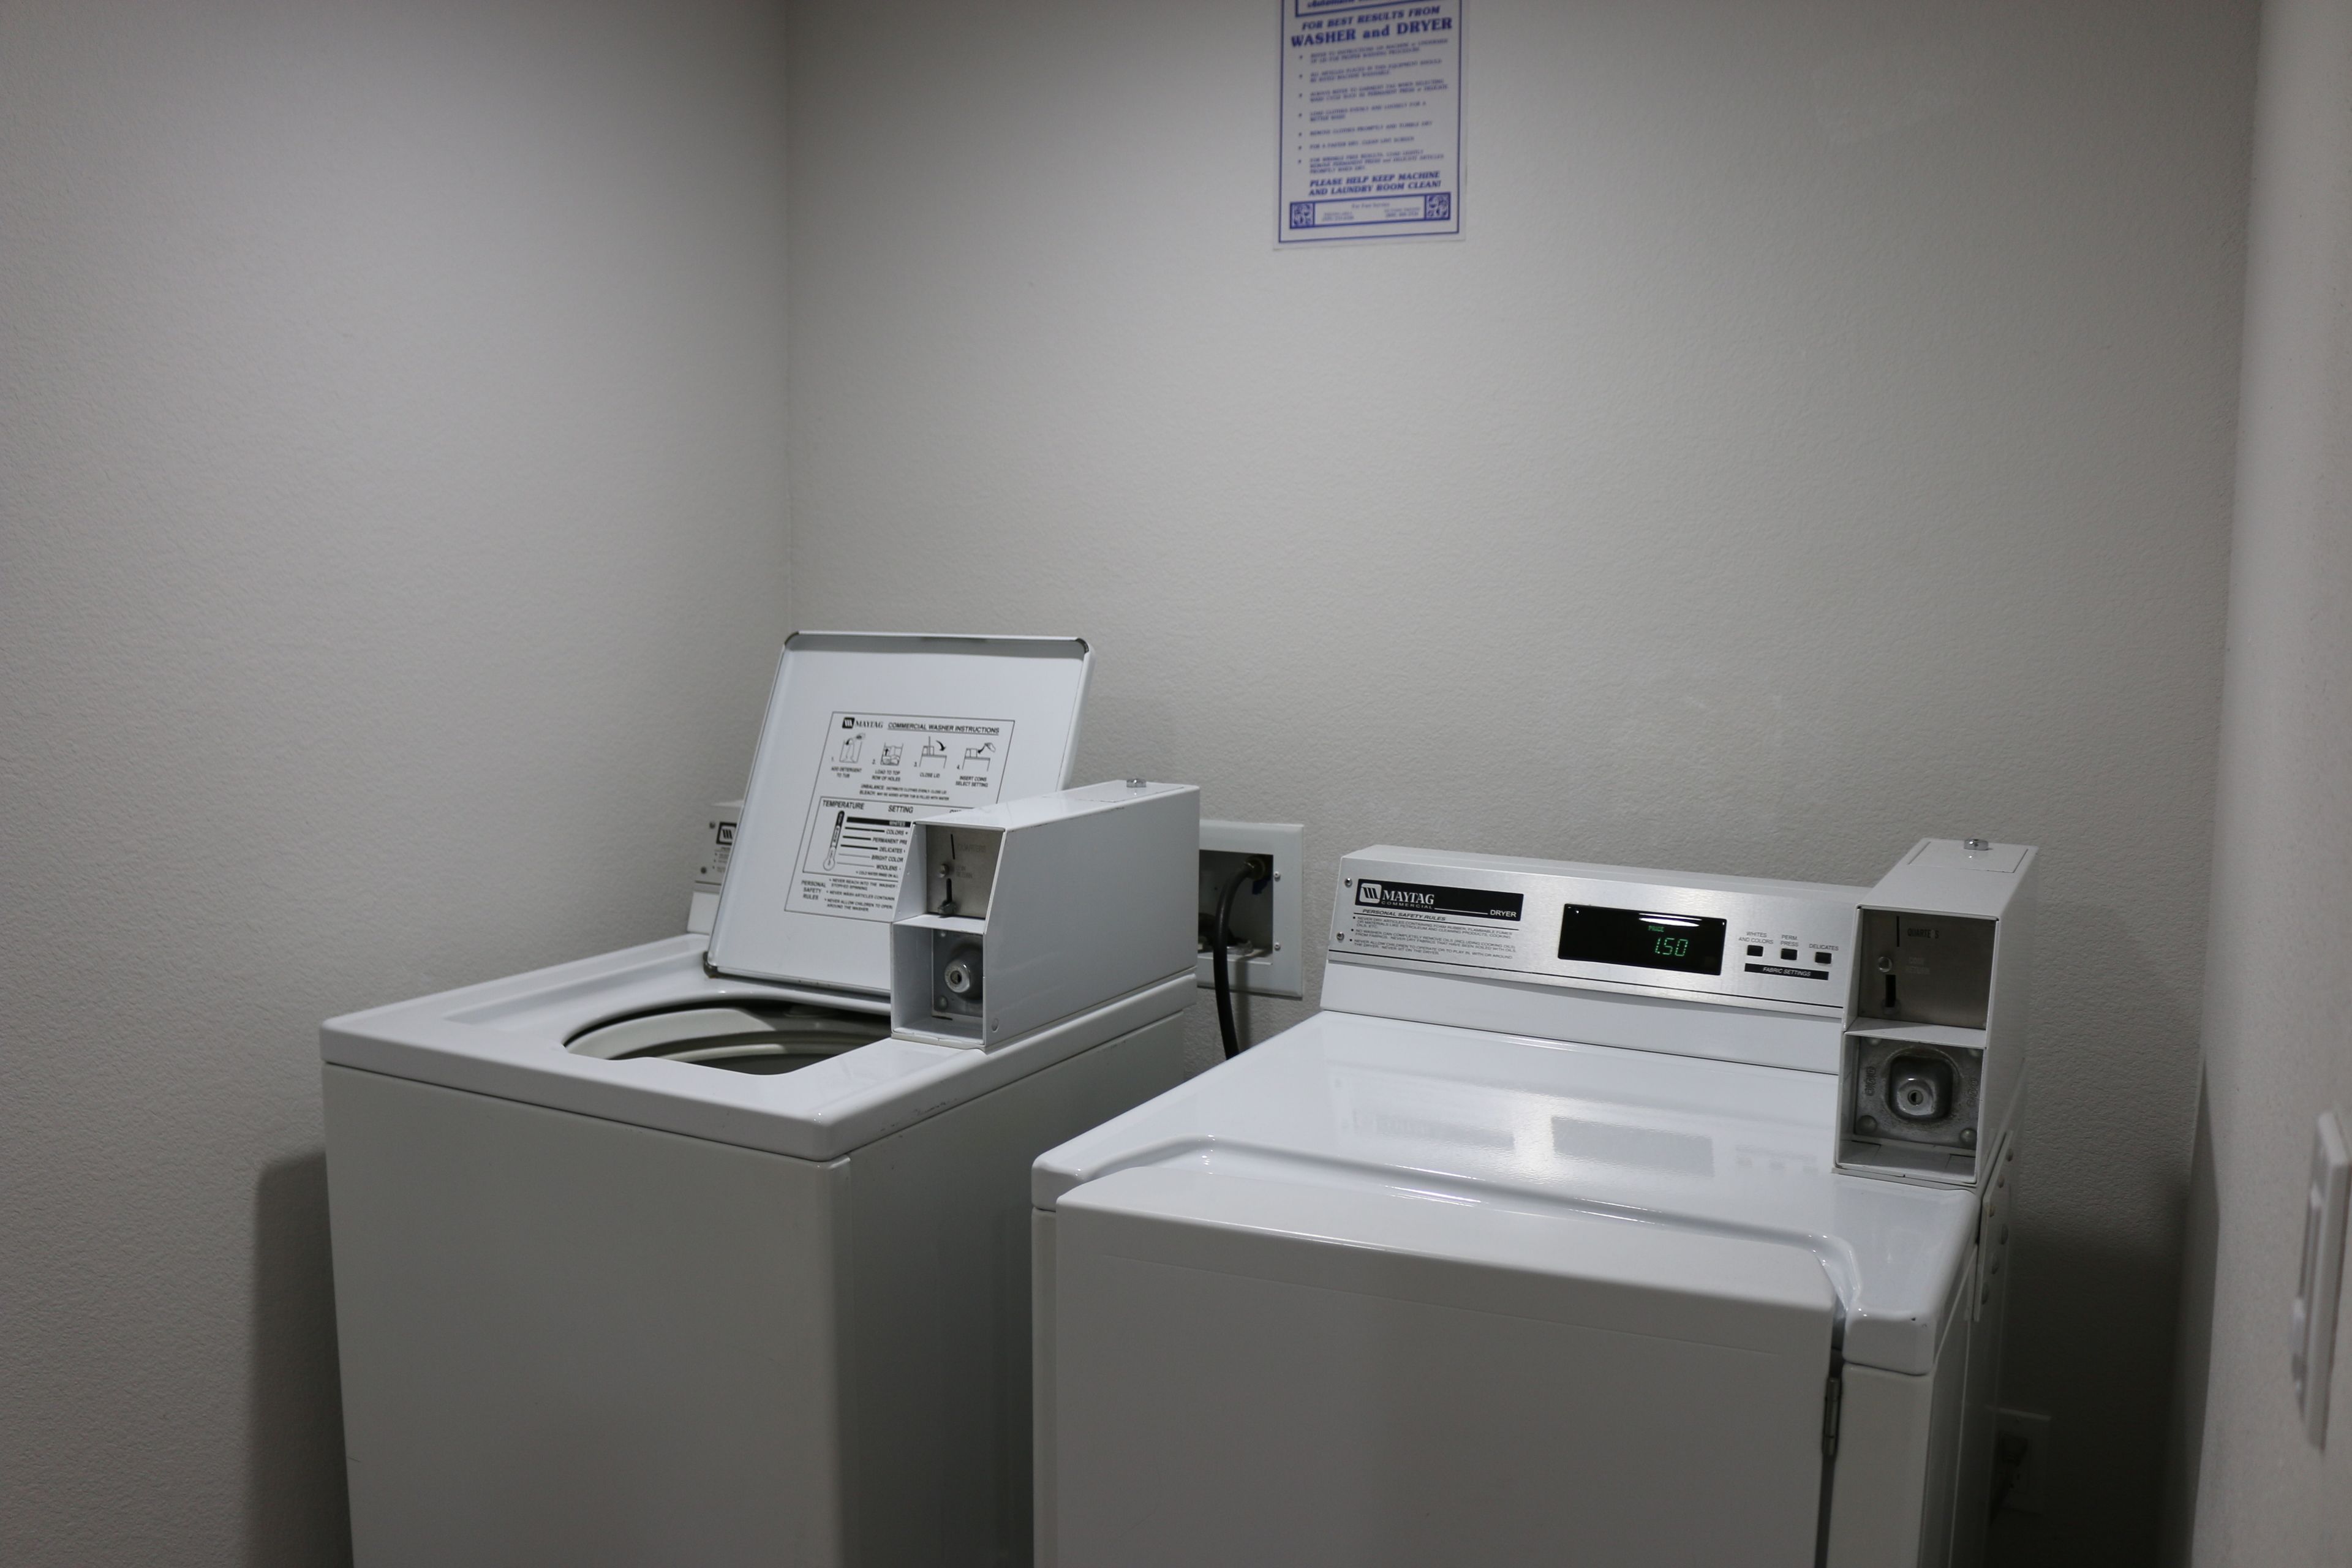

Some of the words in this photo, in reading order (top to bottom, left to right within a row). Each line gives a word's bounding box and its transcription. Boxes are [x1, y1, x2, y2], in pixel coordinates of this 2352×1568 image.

[1302, 20, 1322, 31] FOR
[1327, 17, 1352, 28] BEST
[1357, 11, 1404, 24] RESULTS
[1409, 6, 1440, 17] FROM
[1291, 28, 1355, 47] WASHER
[1363, 24, 1390, 39] and
[1397, 17, 1452, 35] DRYER
[1310, 177, 1342, 187] PLEASE
[1346, 176, 1369, 184] HELP
[1373, 173, 1395, 182] KEEP
[1399, 171, 1439, 180] MACHINE
[1309, 187, 1328, 196] AND
[1331, 184, 1373, 195] LAUNDRY
[1376, 183, 1404, 191] ROOM
[1408, 180, 1441, 189] CLEAN!
[823, 800, 864, 810] TEMPERATURE
[888, 805, 913, 813] SETTING
[1382, 890, 1434, 905] MAYTAG
[1381, 901, 1433, 910] COMMERCIAL
